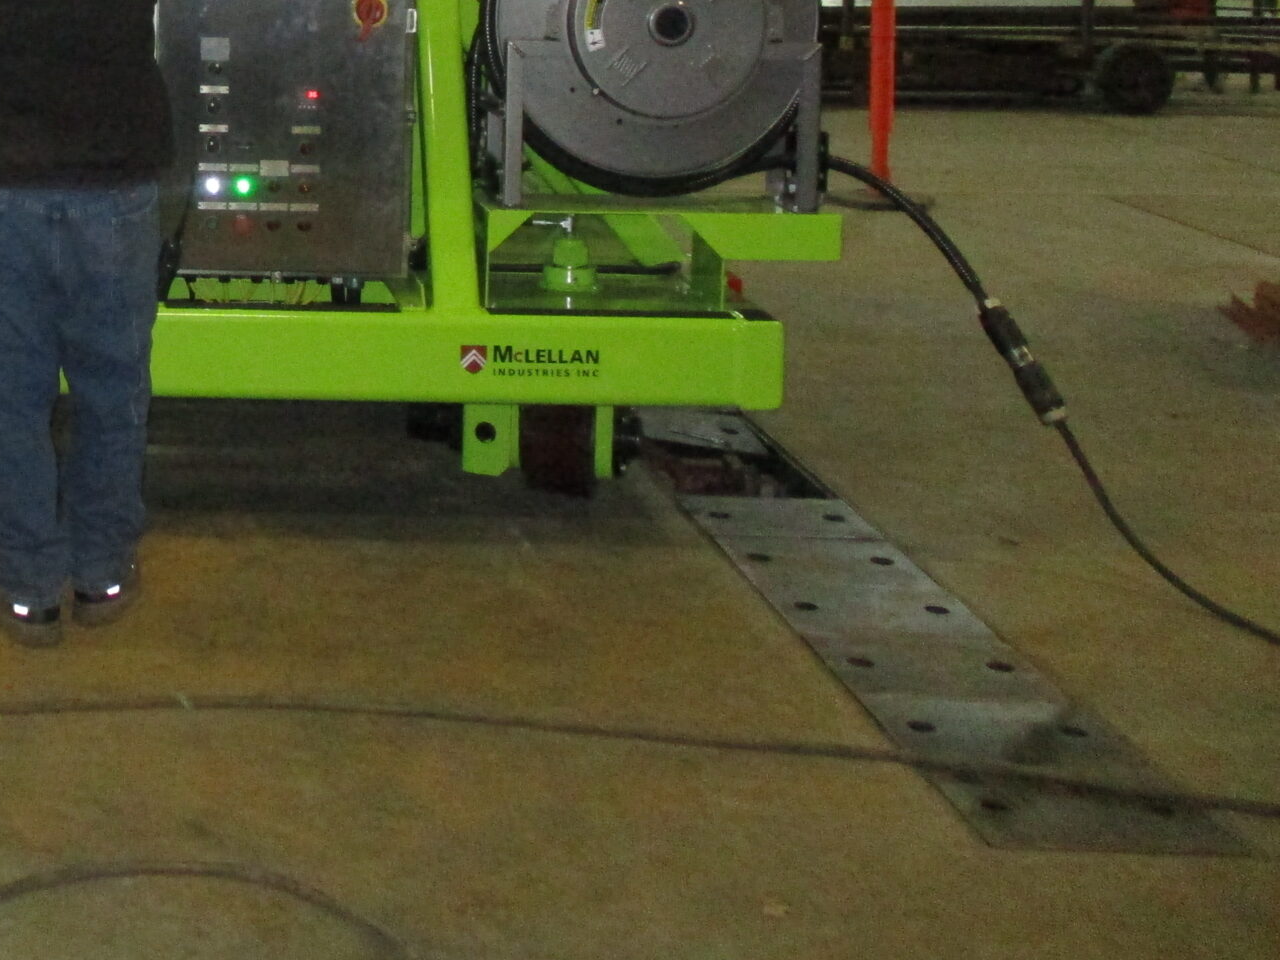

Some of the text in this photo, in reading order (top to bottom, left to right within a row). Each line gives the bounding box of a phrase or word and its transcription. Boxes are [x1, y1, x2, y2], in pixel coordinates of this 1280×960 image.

[493, 345, 599, 364] McLELLAN
[493, 368, 599, 377] INDUSTRIES INC
